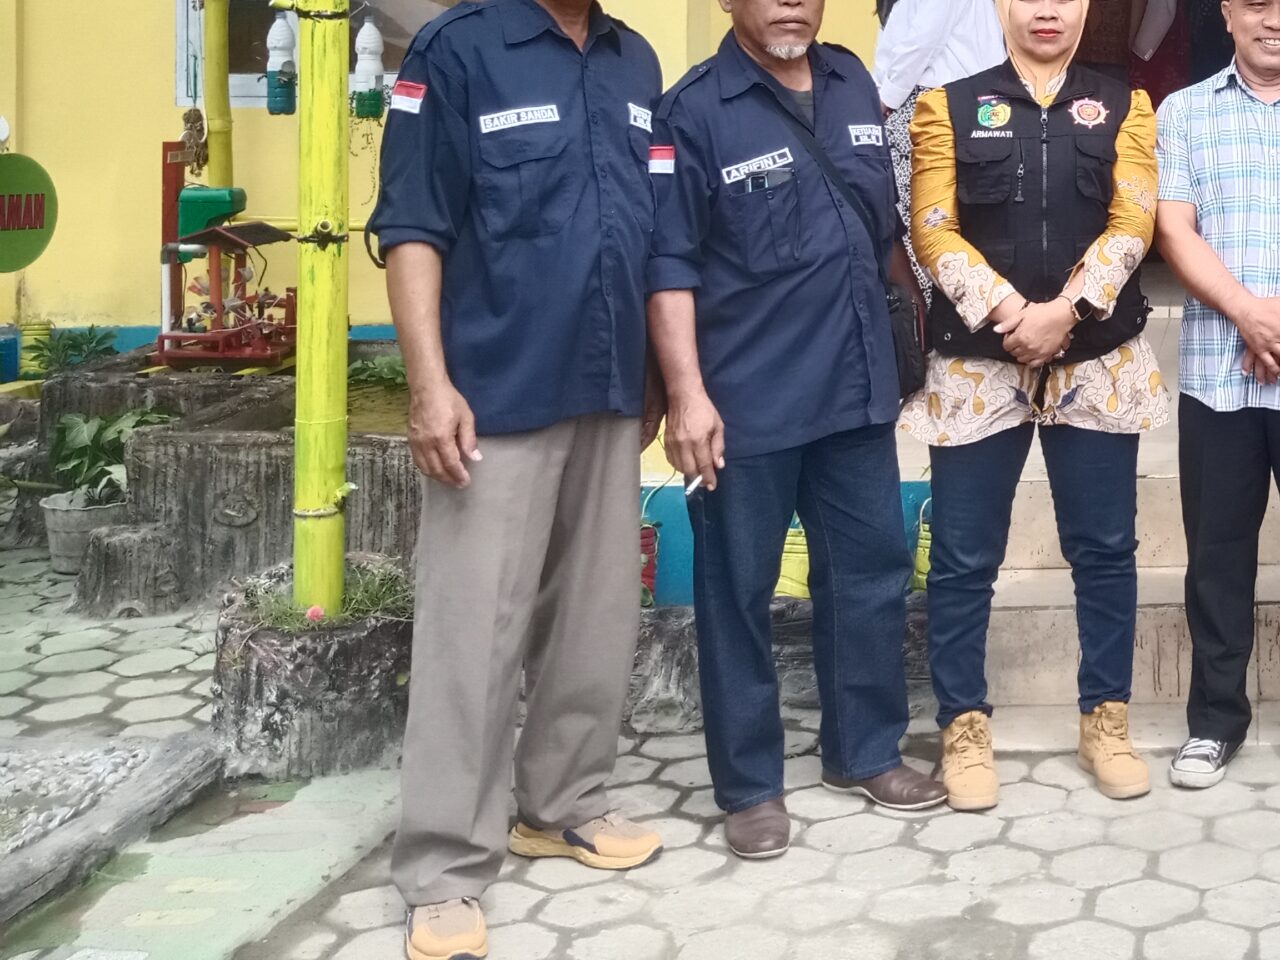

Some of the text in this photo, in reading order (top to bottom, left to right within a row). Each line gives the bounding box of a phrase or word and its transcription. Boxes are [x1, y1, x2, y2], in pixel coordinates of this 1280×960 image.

[484, 109, 553, 128] SAKIR SANDA
[971, 130, 1013, 138] ARMAWATI
[730, 156, 774, 180] ARIFIN
